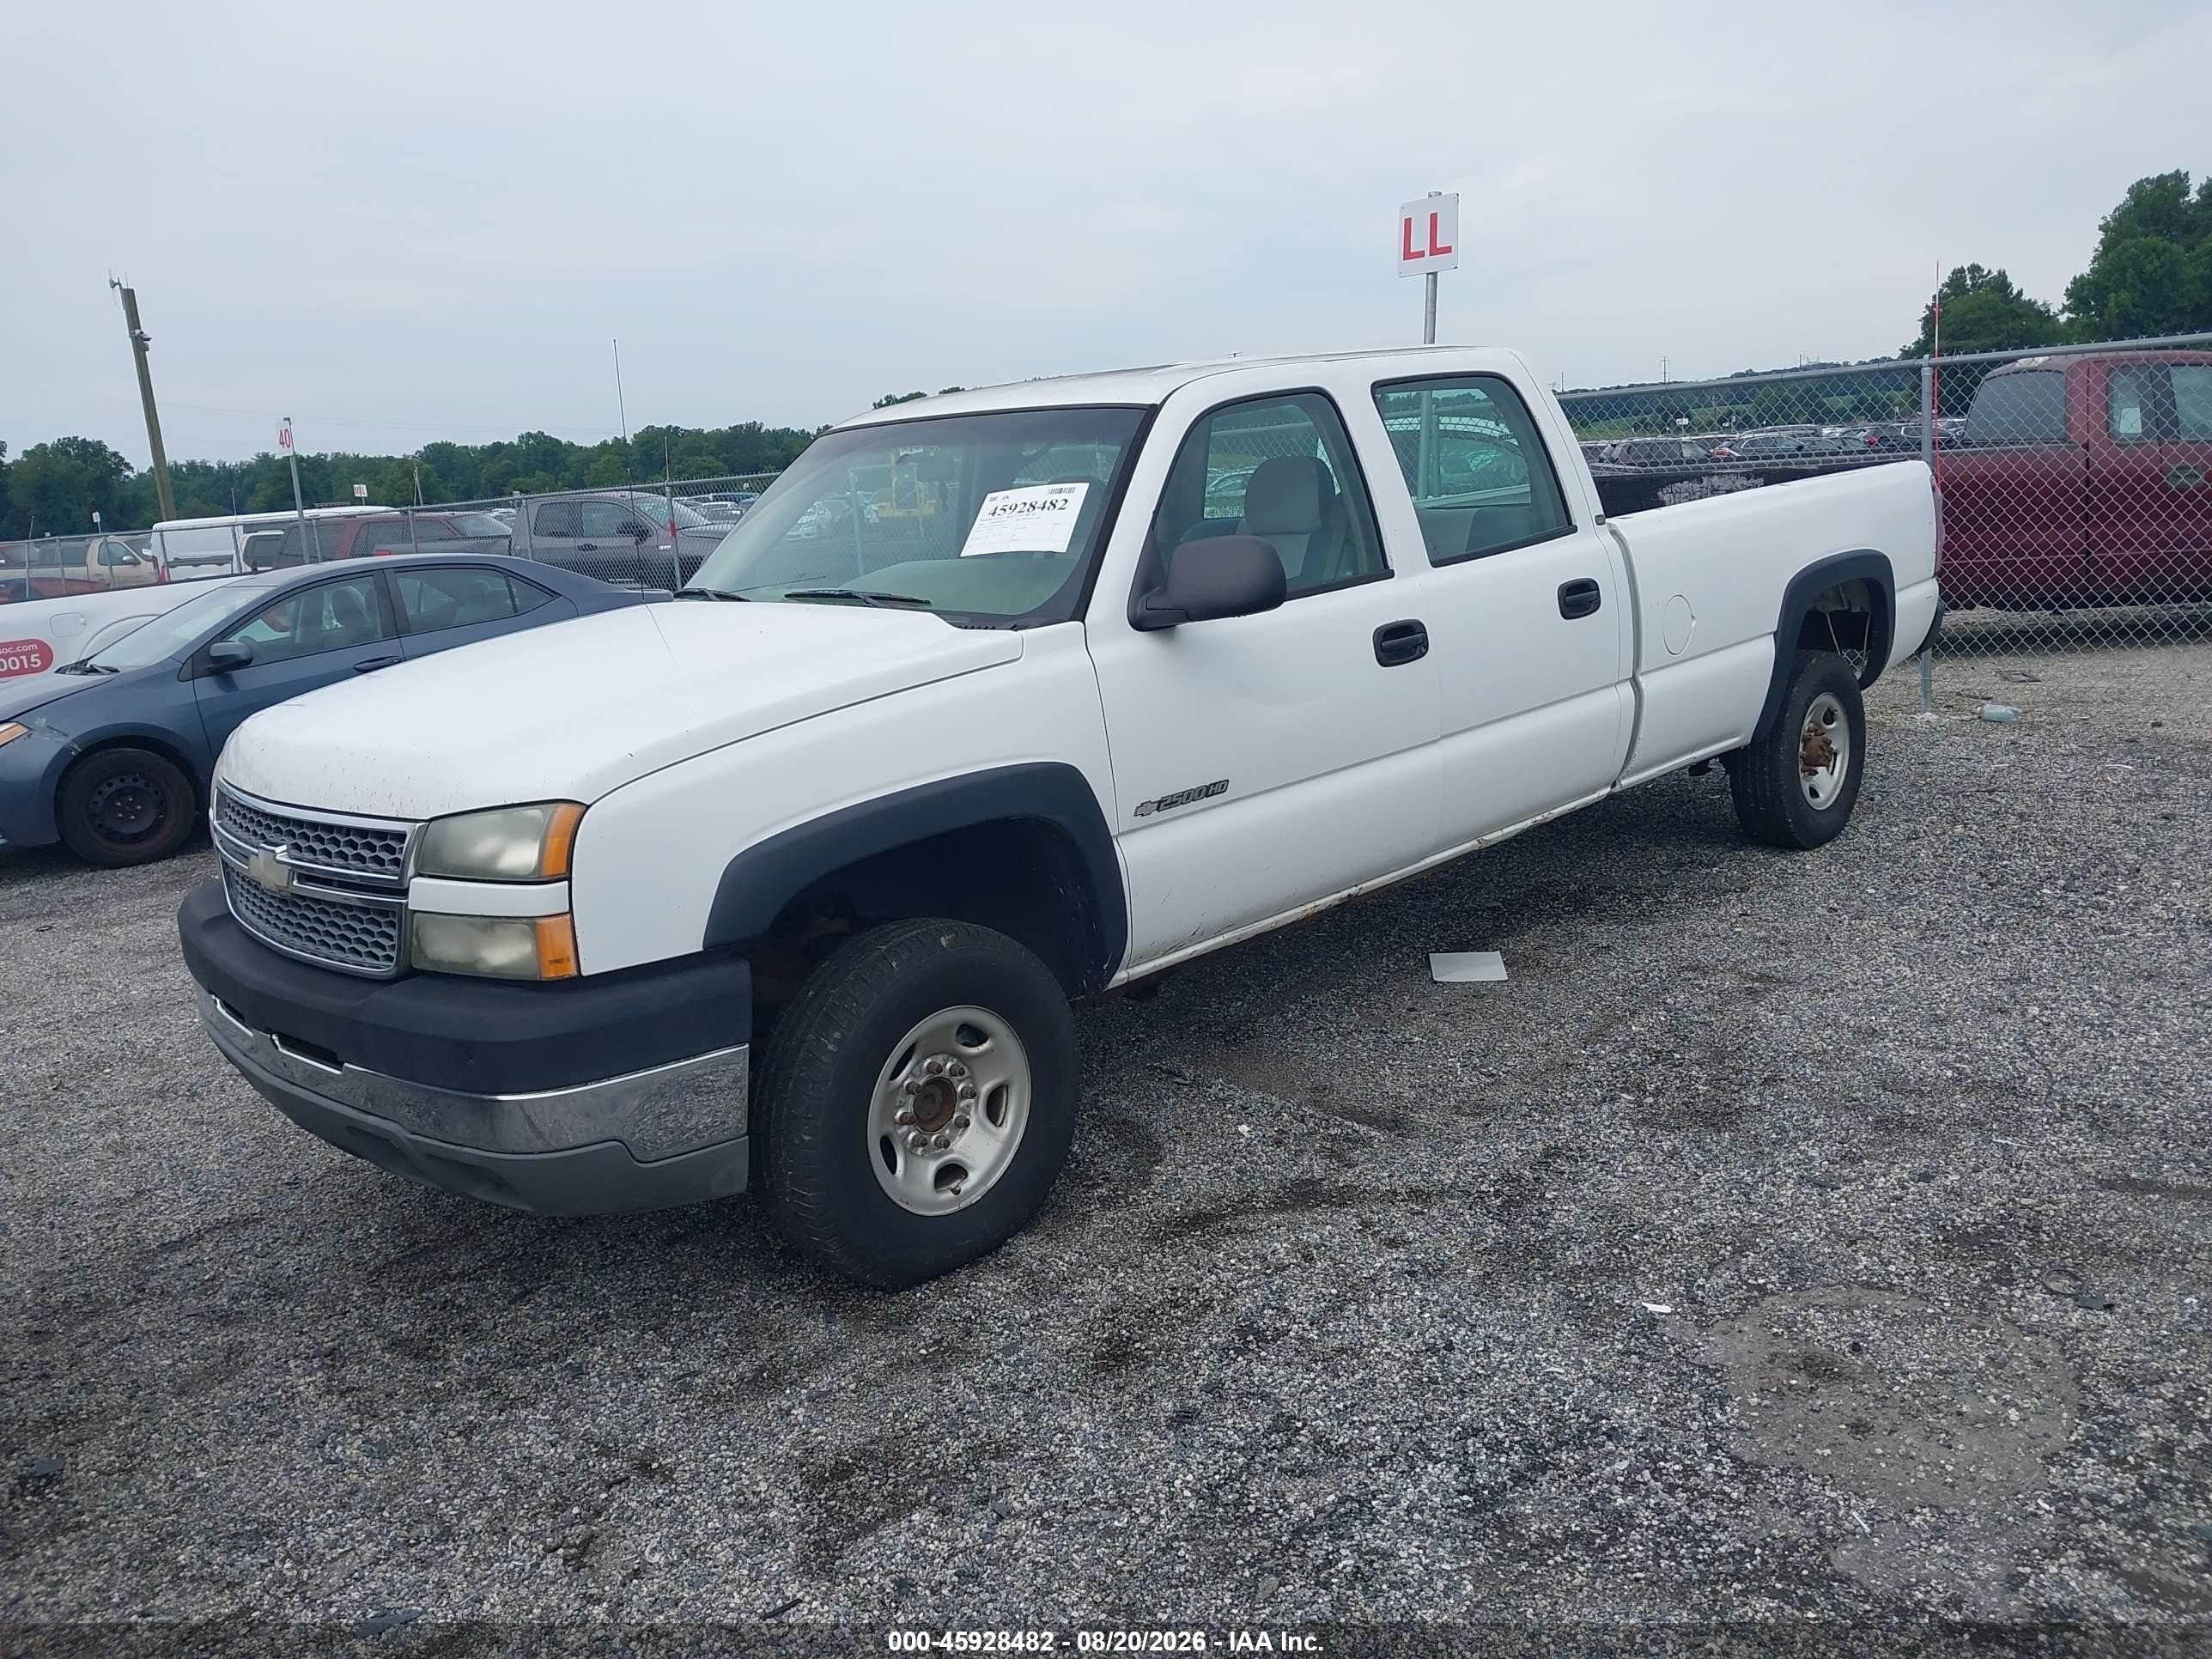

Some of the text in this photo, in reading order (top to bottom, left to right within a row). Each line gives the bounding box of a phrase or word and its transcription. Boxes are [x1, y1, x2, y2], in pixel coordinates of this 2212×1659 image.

[1402, 211, 1452, 261] LL
[279, 428, 291, 448] 40
[988, 498, 1068, 517] 45928482
[1159, 780, 1229, 811] 2500 HD
